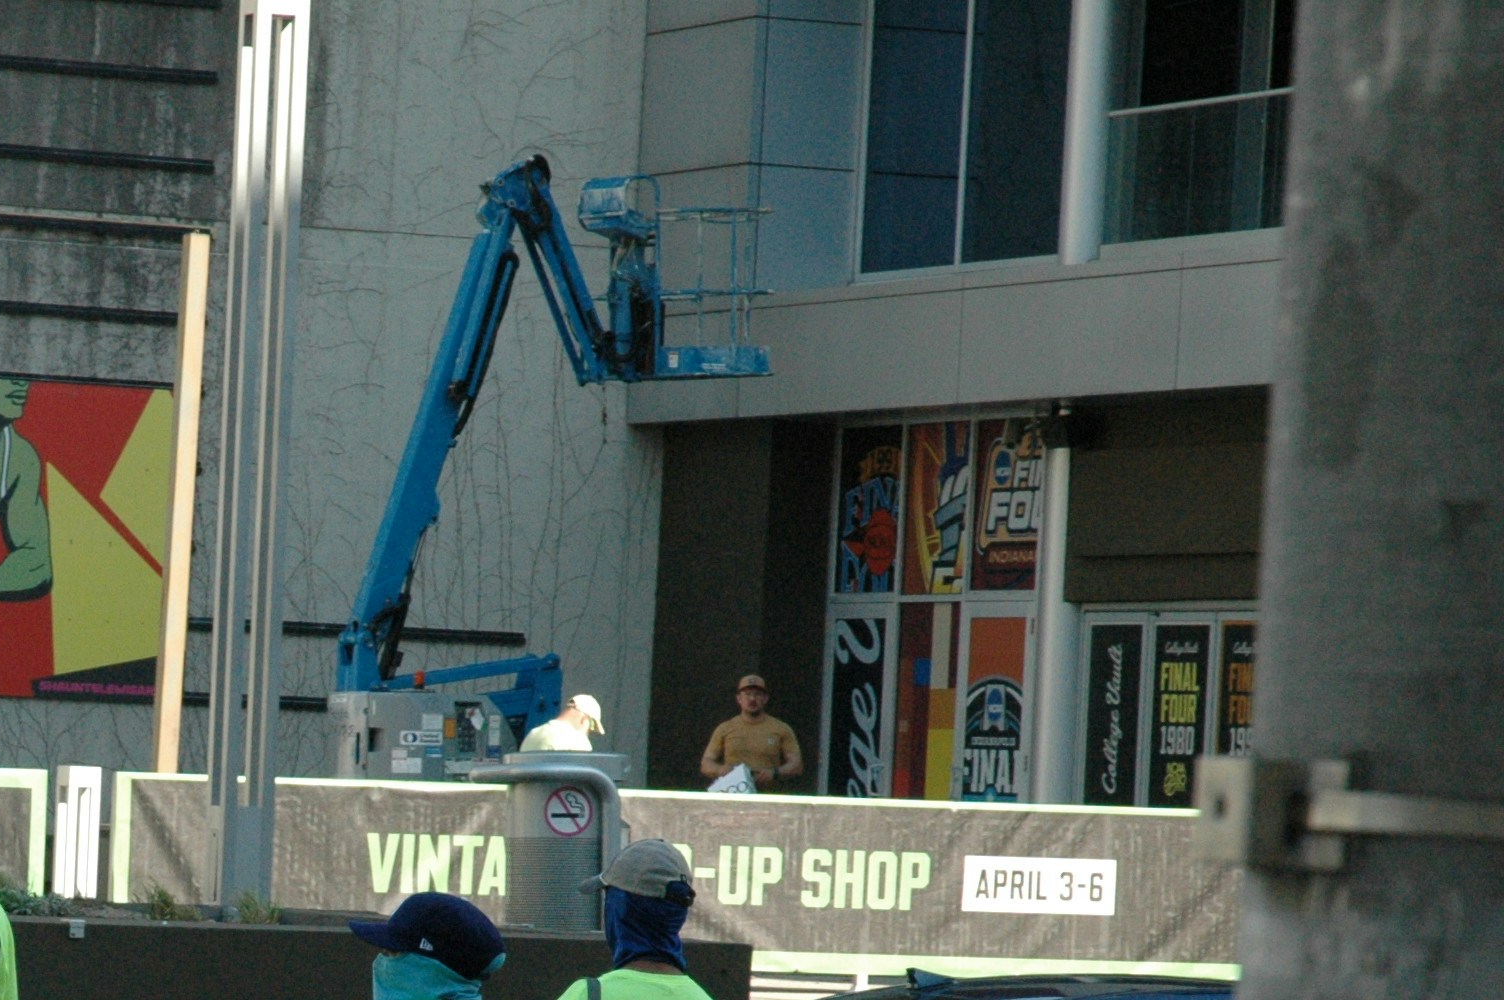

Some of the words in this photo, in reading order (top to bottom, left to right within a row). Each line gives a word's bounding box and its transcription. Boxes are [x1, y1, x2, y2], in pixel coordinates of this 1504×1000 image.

[1106, 643, 1123, 705] Vault
[1160, 661, 1200, 691] FINAL
[1228, 662, 1254, 692] FIN
[1160, 693, 1197, 723] FOUR
[1228, 694, 1253, 724] FO
[1102, 709, 1123, 794] College
[1160, 725, 1195, 756] 1980
[367, 832, 507, 897] VINTA
[800, 847, 932, 911] SHOP
[975, 868, 1047, 900] APRIL
[1059, 871, 1104, 902] 3-6
